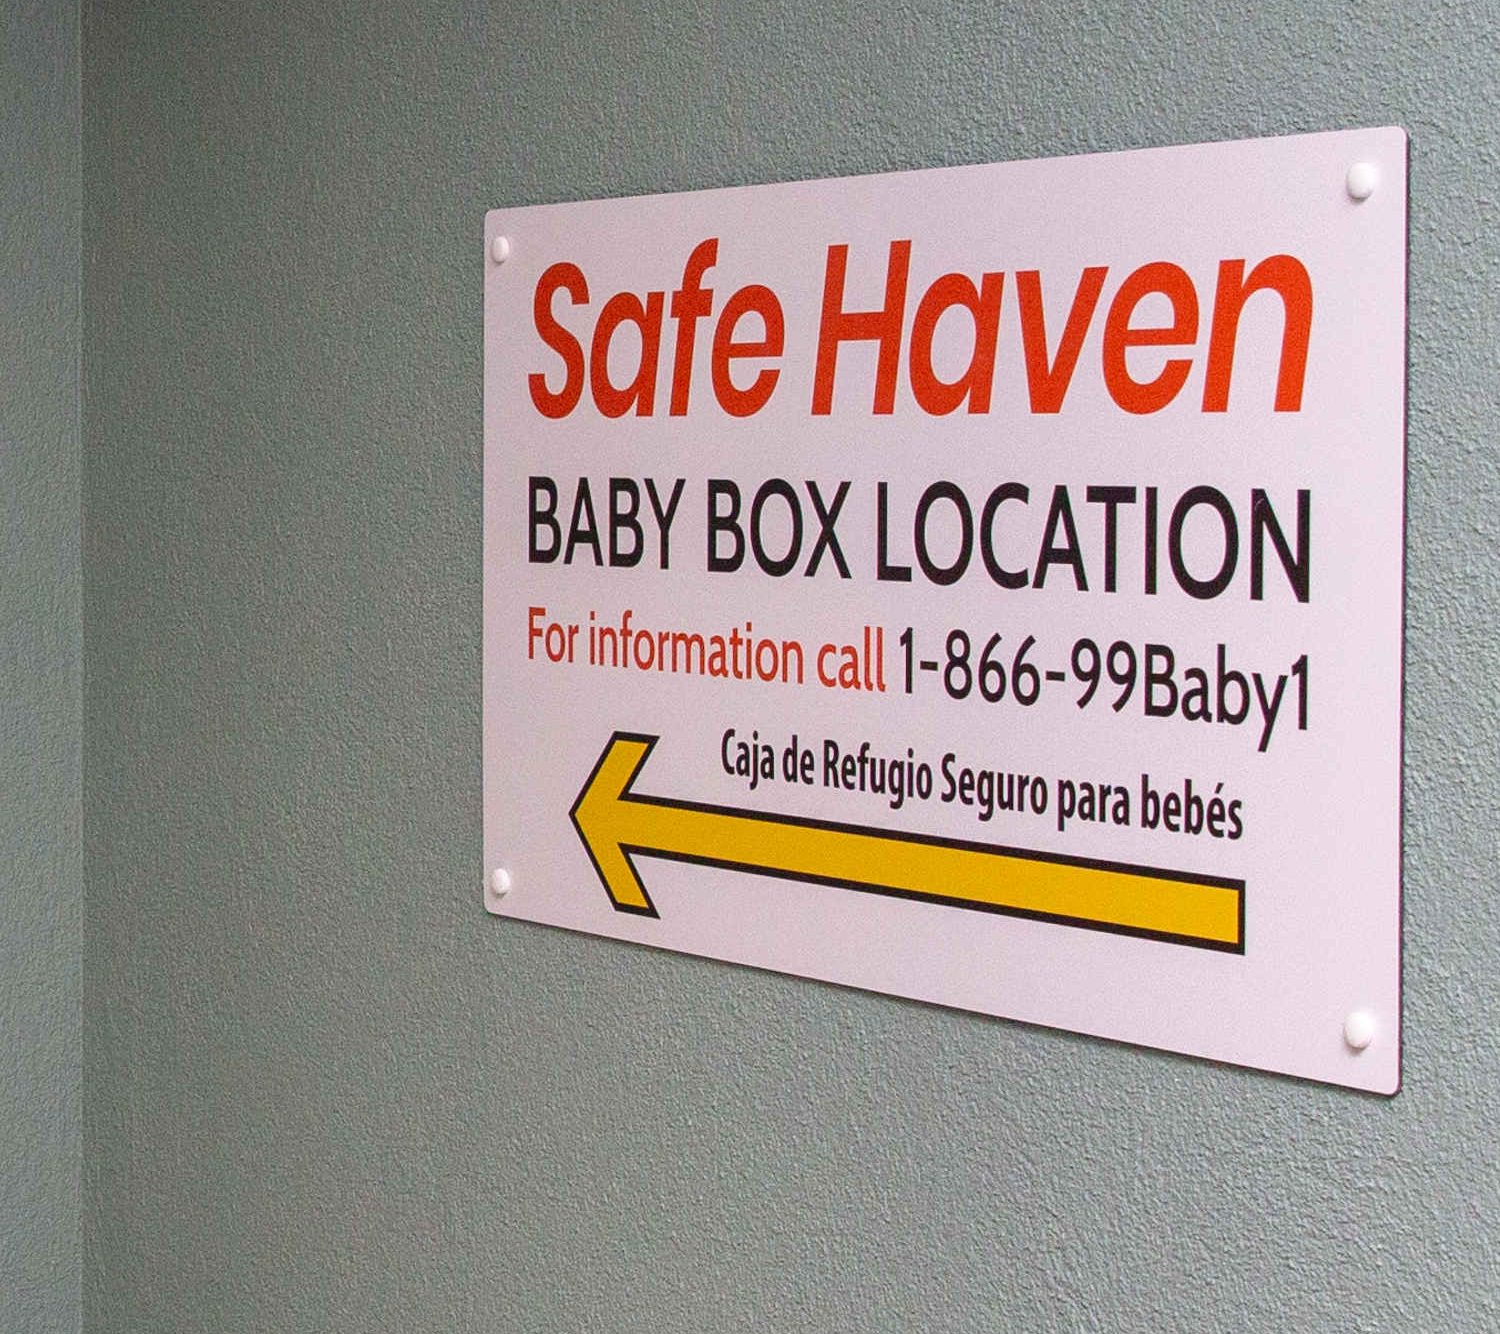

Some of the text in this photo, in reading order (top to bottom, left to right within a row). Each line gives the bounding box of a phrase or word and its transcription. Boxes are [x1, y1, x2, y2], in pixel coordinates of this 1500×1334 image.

[528, 238, 1313, 419] Safe Haven
[528, 476, 1310, 603] BABY BOX LOCATION
[528, 607, 1307, 752] For information call 1-866-99Baby1
[721, 728, 1242, 840] Caja de Refugio Seguro para bebés
